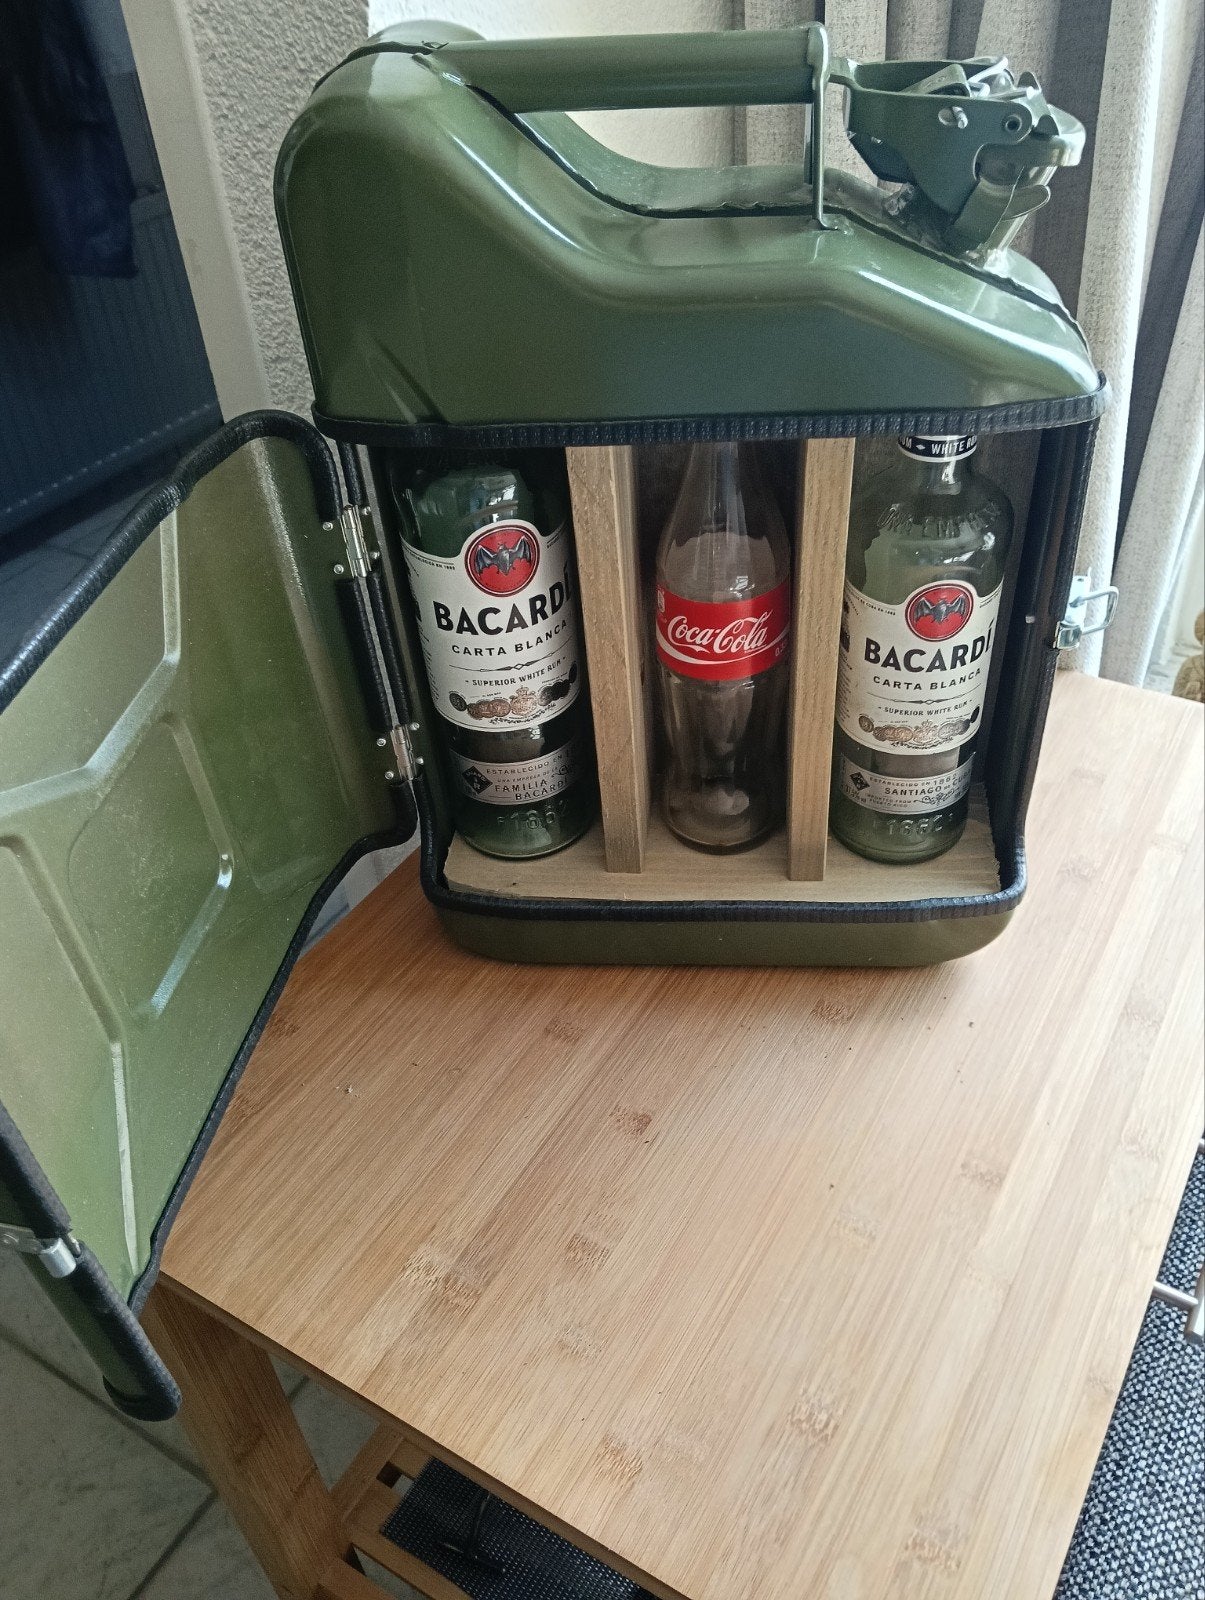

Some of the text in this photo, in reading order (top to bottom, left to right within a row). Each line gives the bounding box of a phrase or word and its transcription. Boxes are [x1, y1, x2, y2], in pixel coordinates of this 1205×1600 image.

[931, 440, 966, 455] WHITE
[451, 619, 568, 657] CARTA BLANCA
[667, 608, 774, 654] Coca-Cola
[864, 618, 995, 673] BACARDÍ
[472, 677, 516, 687] SUPERIOR
[519, 669, 546, 683] WHITE
[546, 658, 562, 672] RUM
[873, 667, 981, 691] CARTA BLANCA
[884, 706, 924, 716] SUPERIOR
[927, 706, 952, 716] WHITE
[953, 701, 968, 712] RUM
[486, 761, 550, 775] ESTABLECIDO
[494, 778, 548, 793] FAMILIA
[884, 785, 942, 796] SANTIAGO
